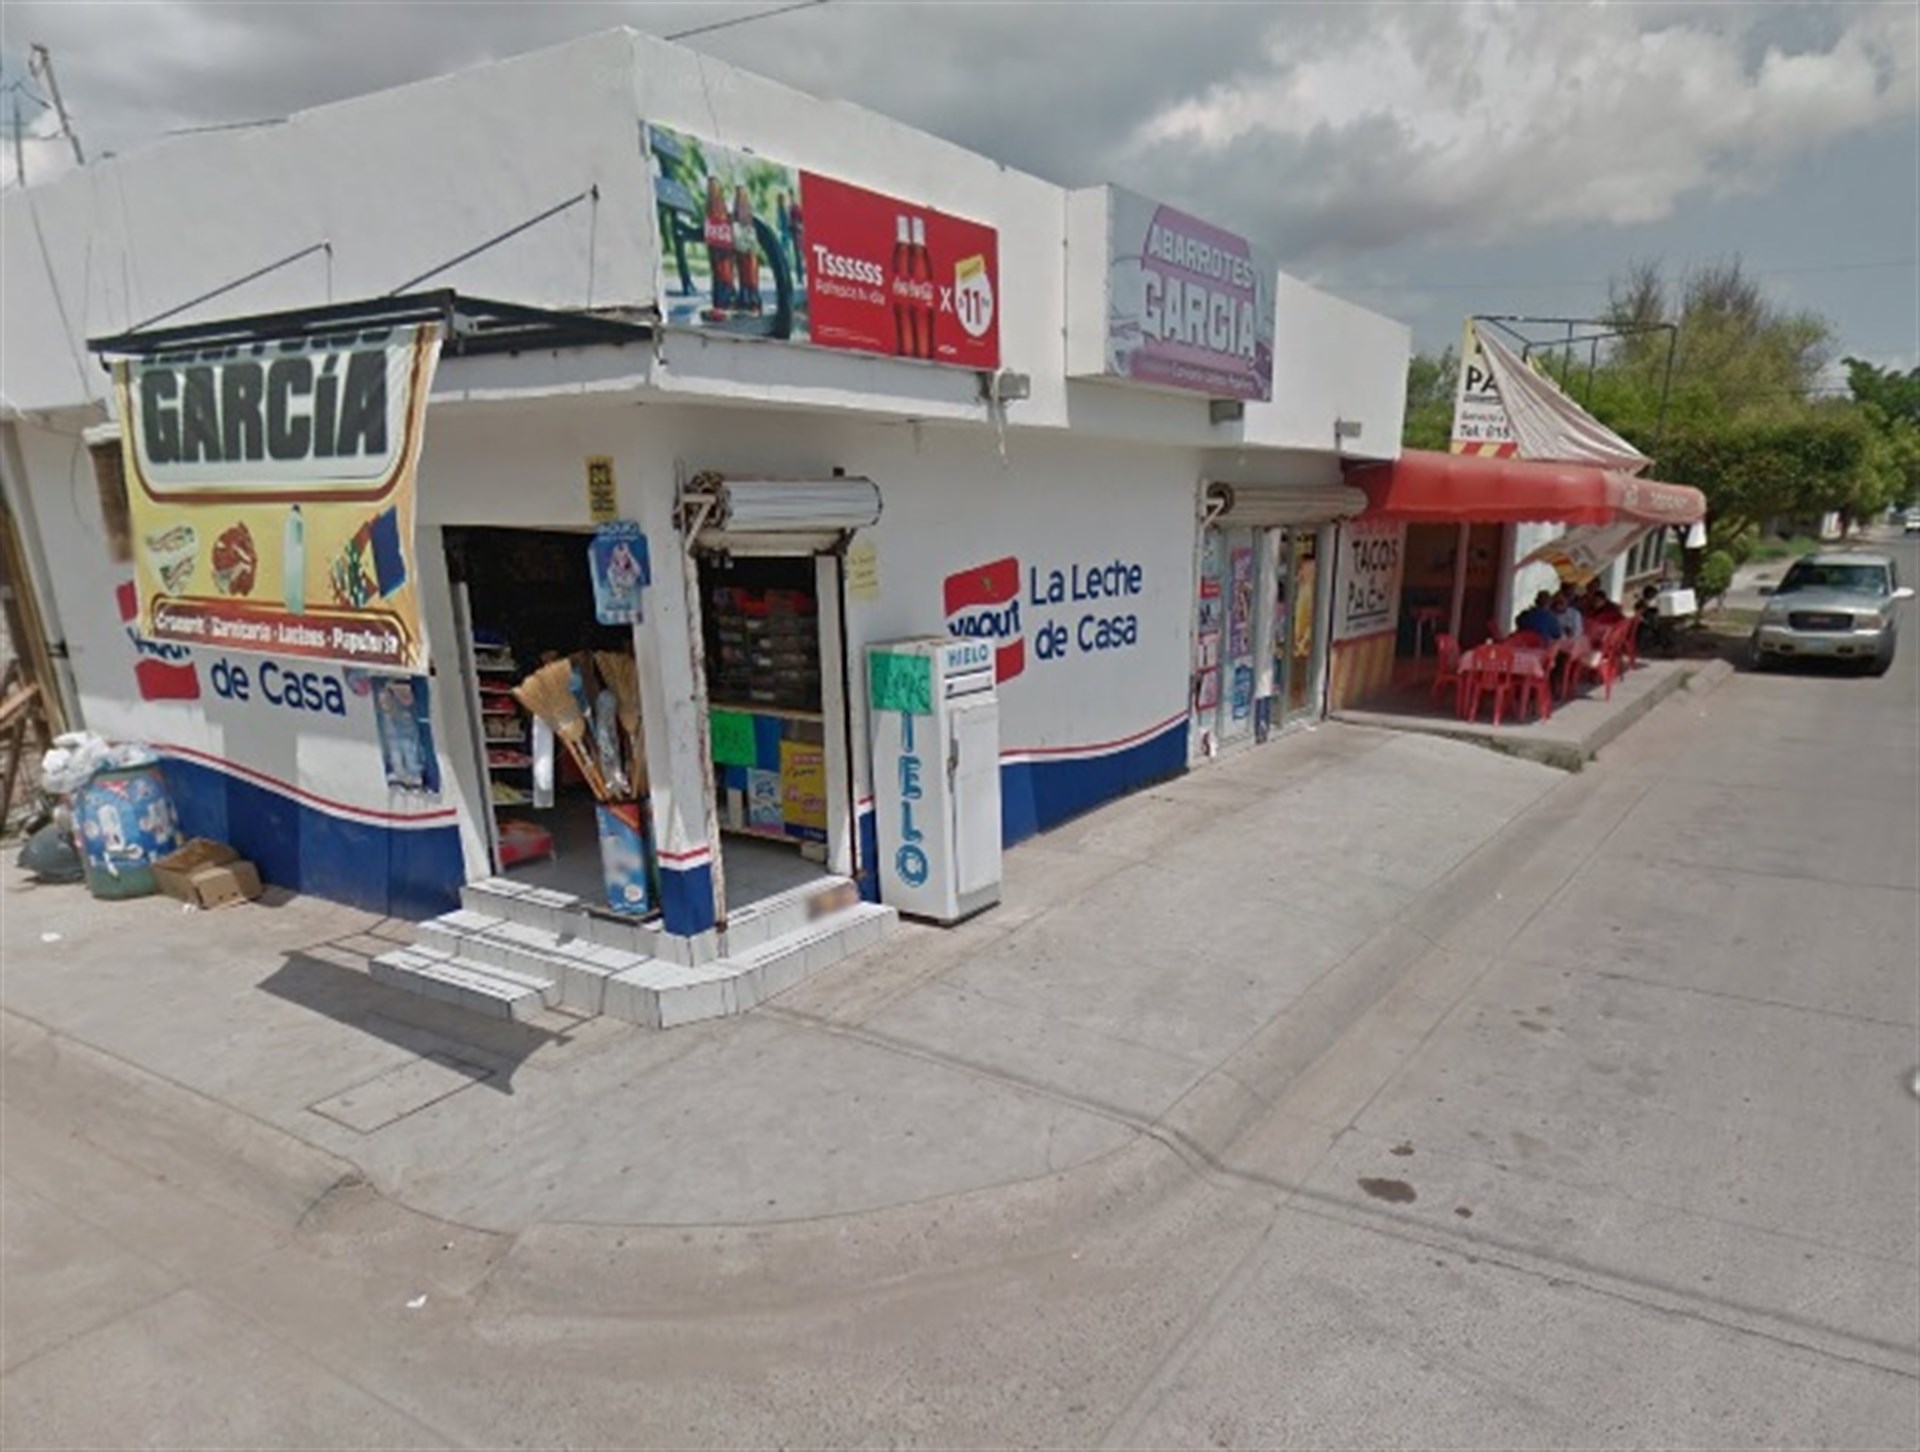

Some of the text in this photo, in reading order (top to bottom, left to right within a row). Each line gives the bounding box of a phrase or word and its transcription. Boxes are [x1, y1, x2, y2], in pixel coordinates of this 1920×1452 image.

[1148, 224, 1254, 287] ABARROTES
[1140, 268, 1256, 356] GARCIA
[1030, 560, 1142, 605] La Leche
[1352, 539, 1398, 574] TACOS
[946, 644, 988, 668] HIELO
[1035, 614, 1137, 660] de Casa
[210, 657, 346, 717] de Casa
[896, 711, 928, 888] IELO
